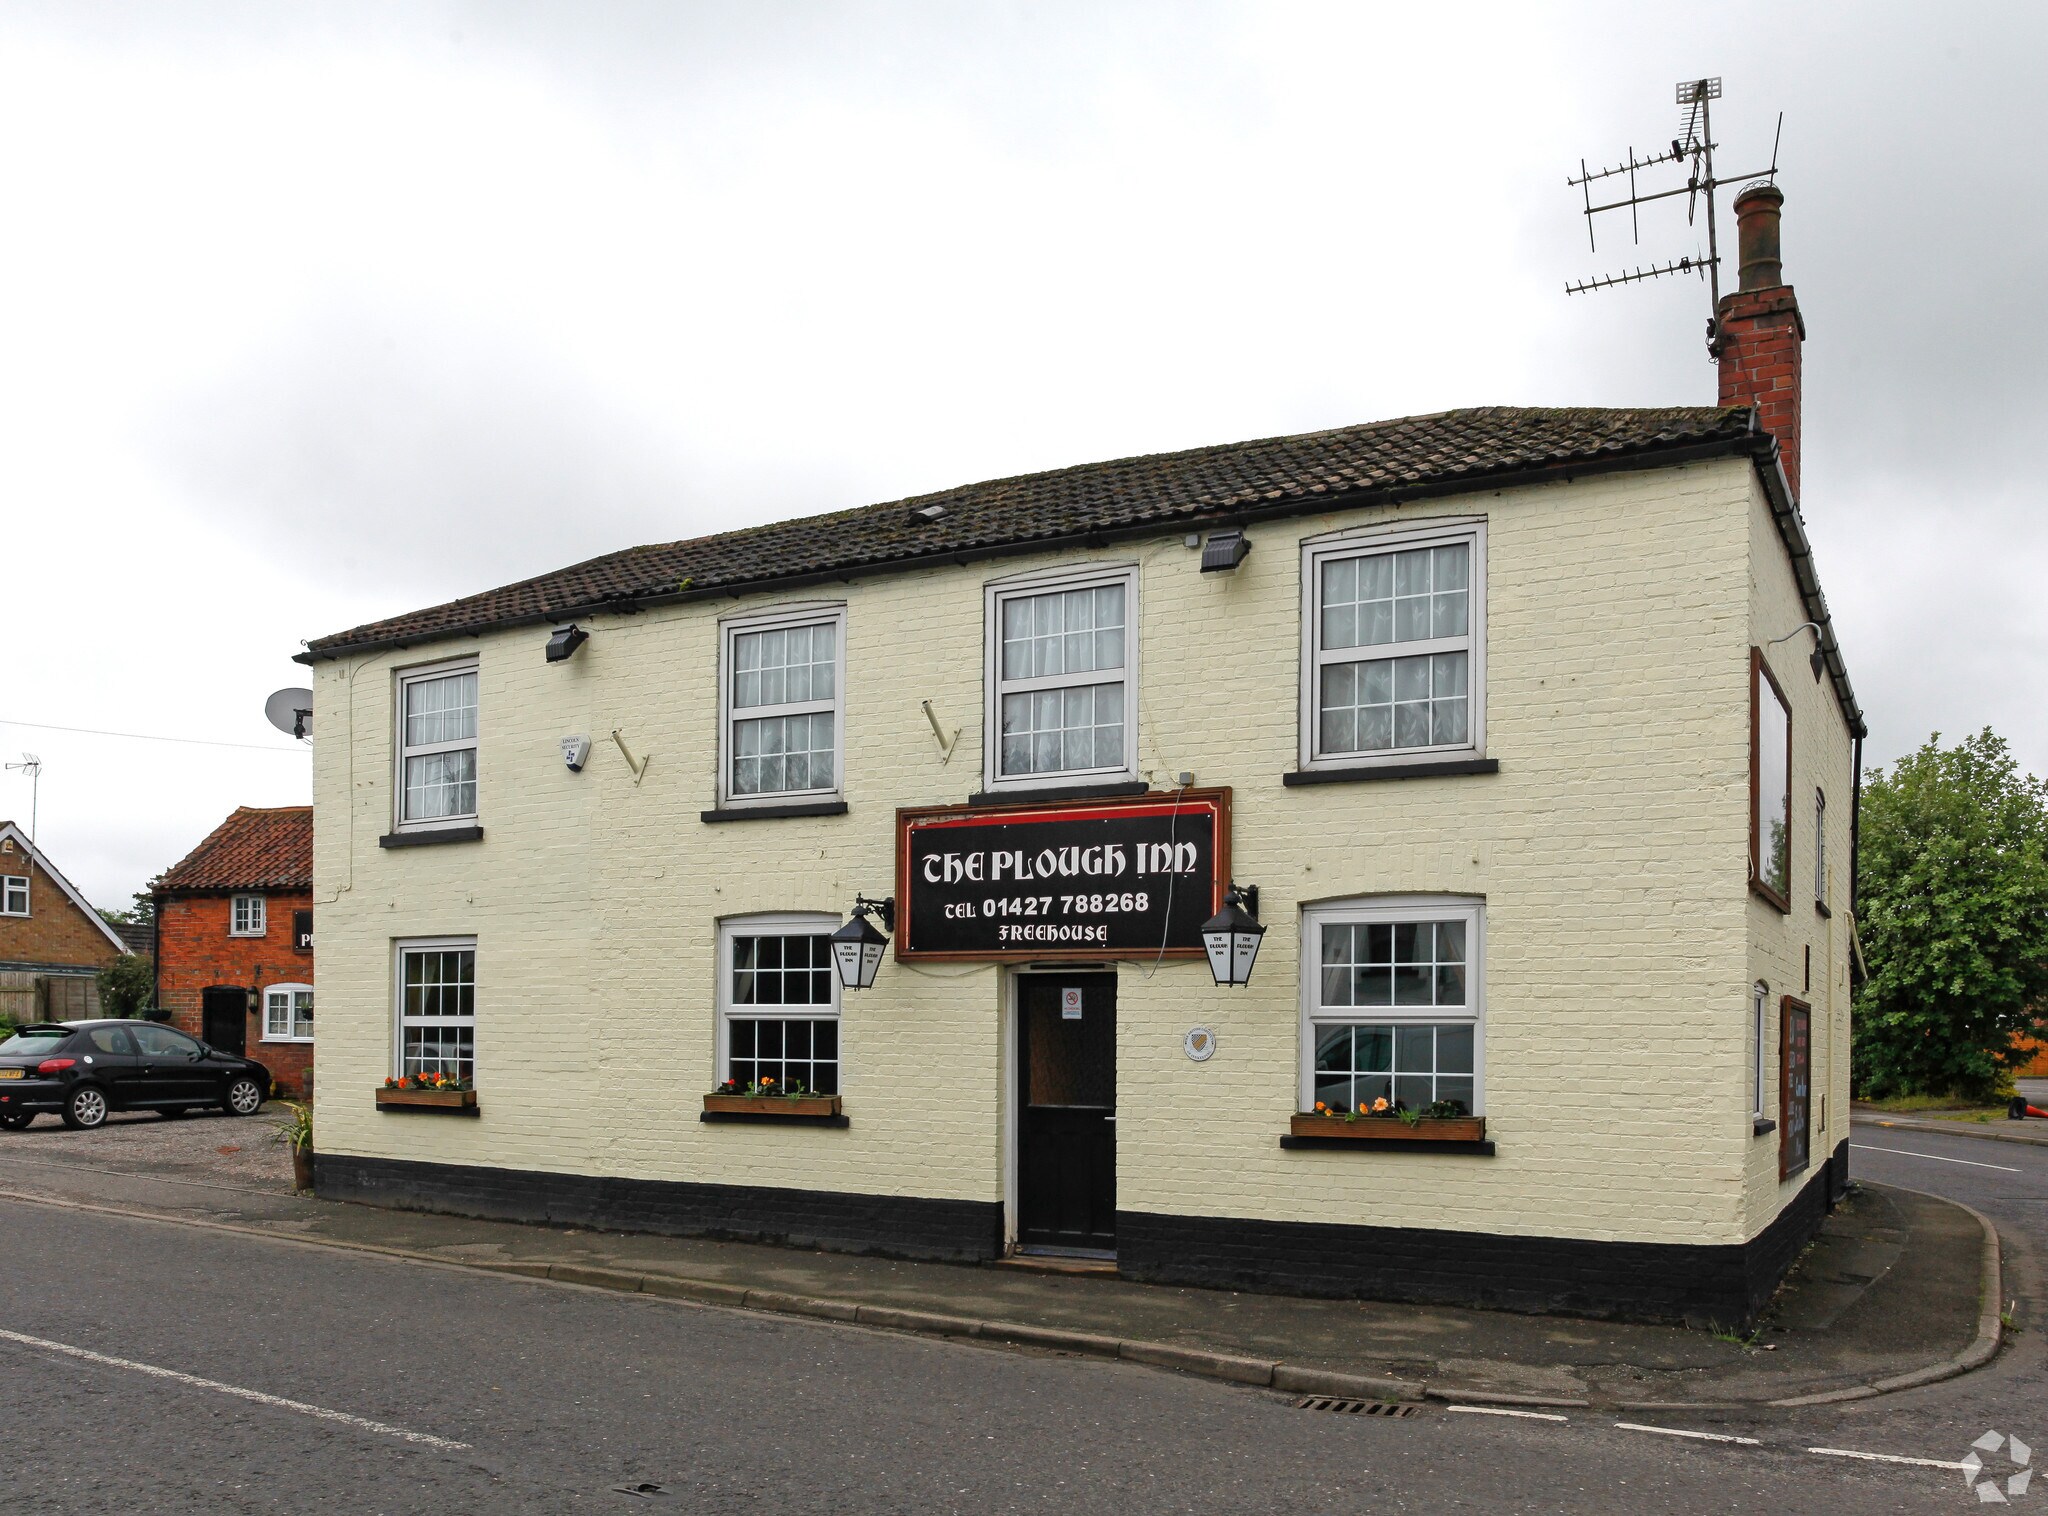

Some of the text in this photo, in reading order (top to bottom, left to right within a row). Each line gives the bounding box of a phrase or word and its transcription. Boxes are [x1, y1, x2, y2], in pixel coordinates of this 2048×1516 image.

[922, 842, 1197, 883] THE PLOUGH INN
[944, 892, 1149, 919] TEL 01427 788268
[999, 924, 1108, 942] FREEHOUSE
